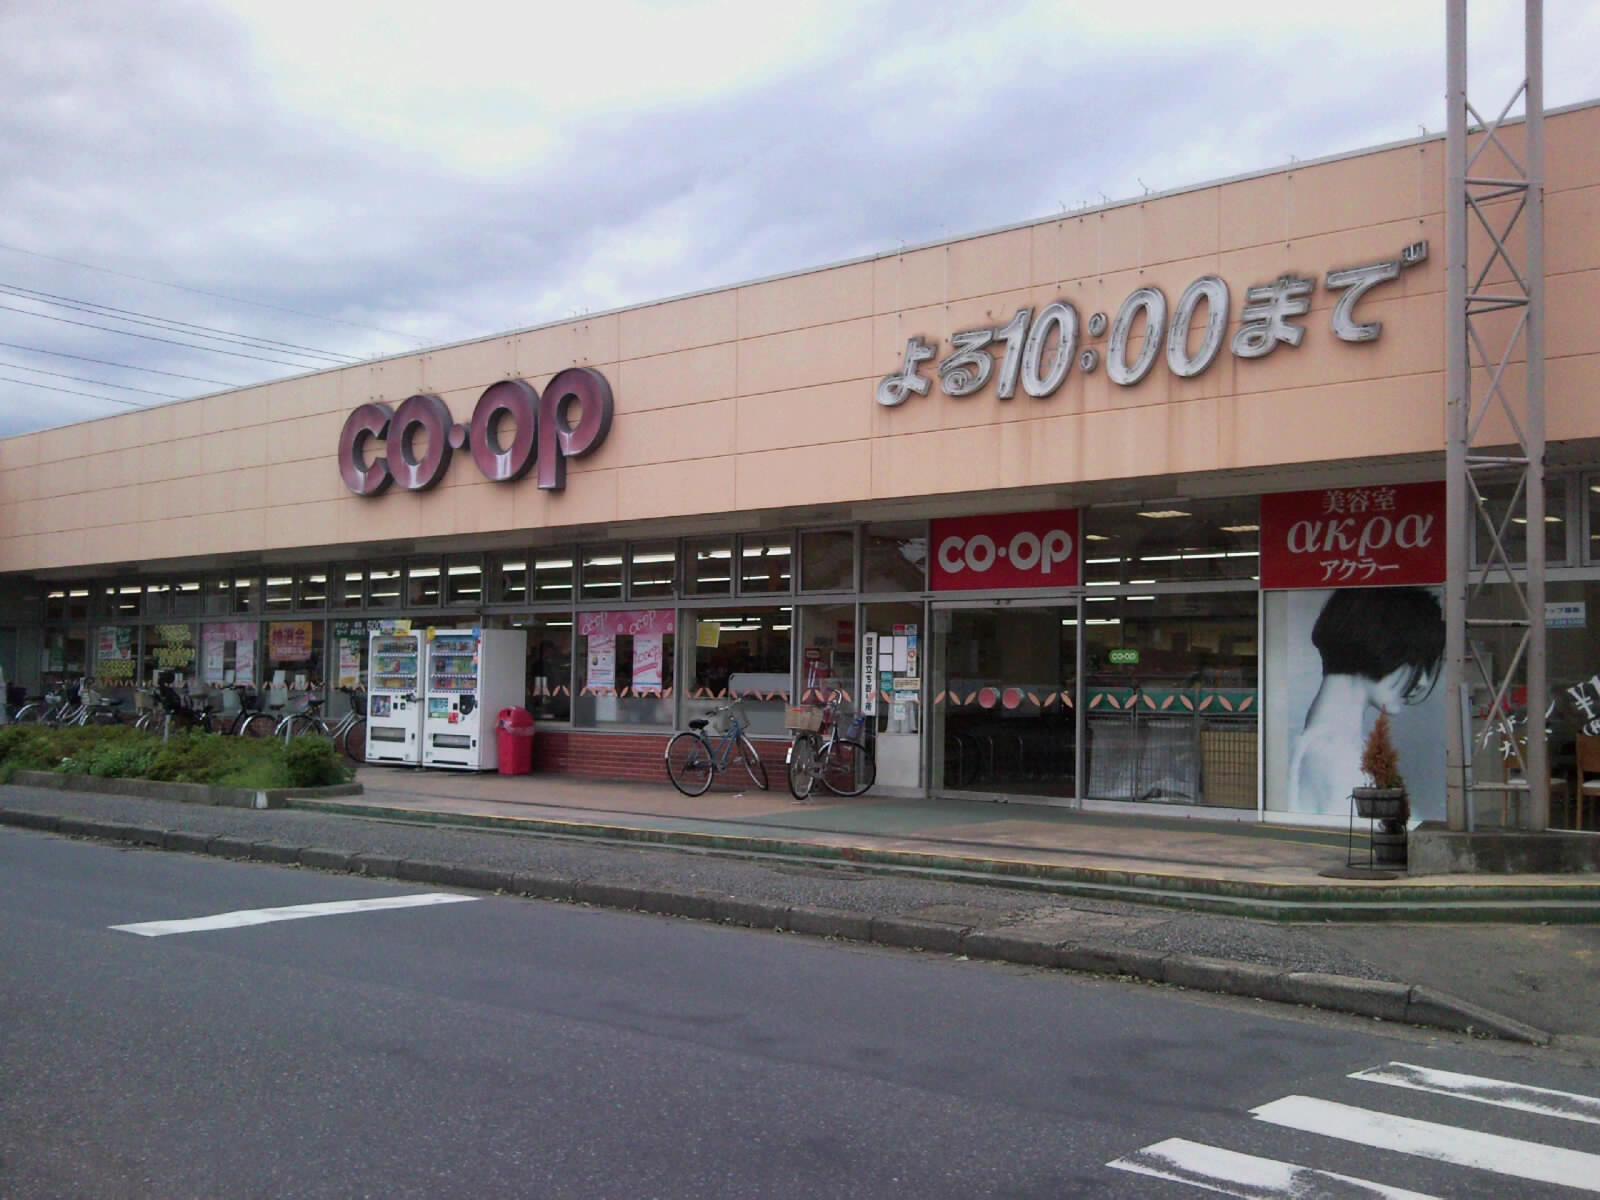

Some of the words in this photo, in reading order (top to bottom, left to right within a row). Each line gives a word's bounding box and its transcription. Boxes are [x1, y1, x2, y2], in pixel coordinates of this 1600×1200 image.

[1323, 487, 1397, 514] 美容室
[1320, 557, 1399, 581] アクラー
